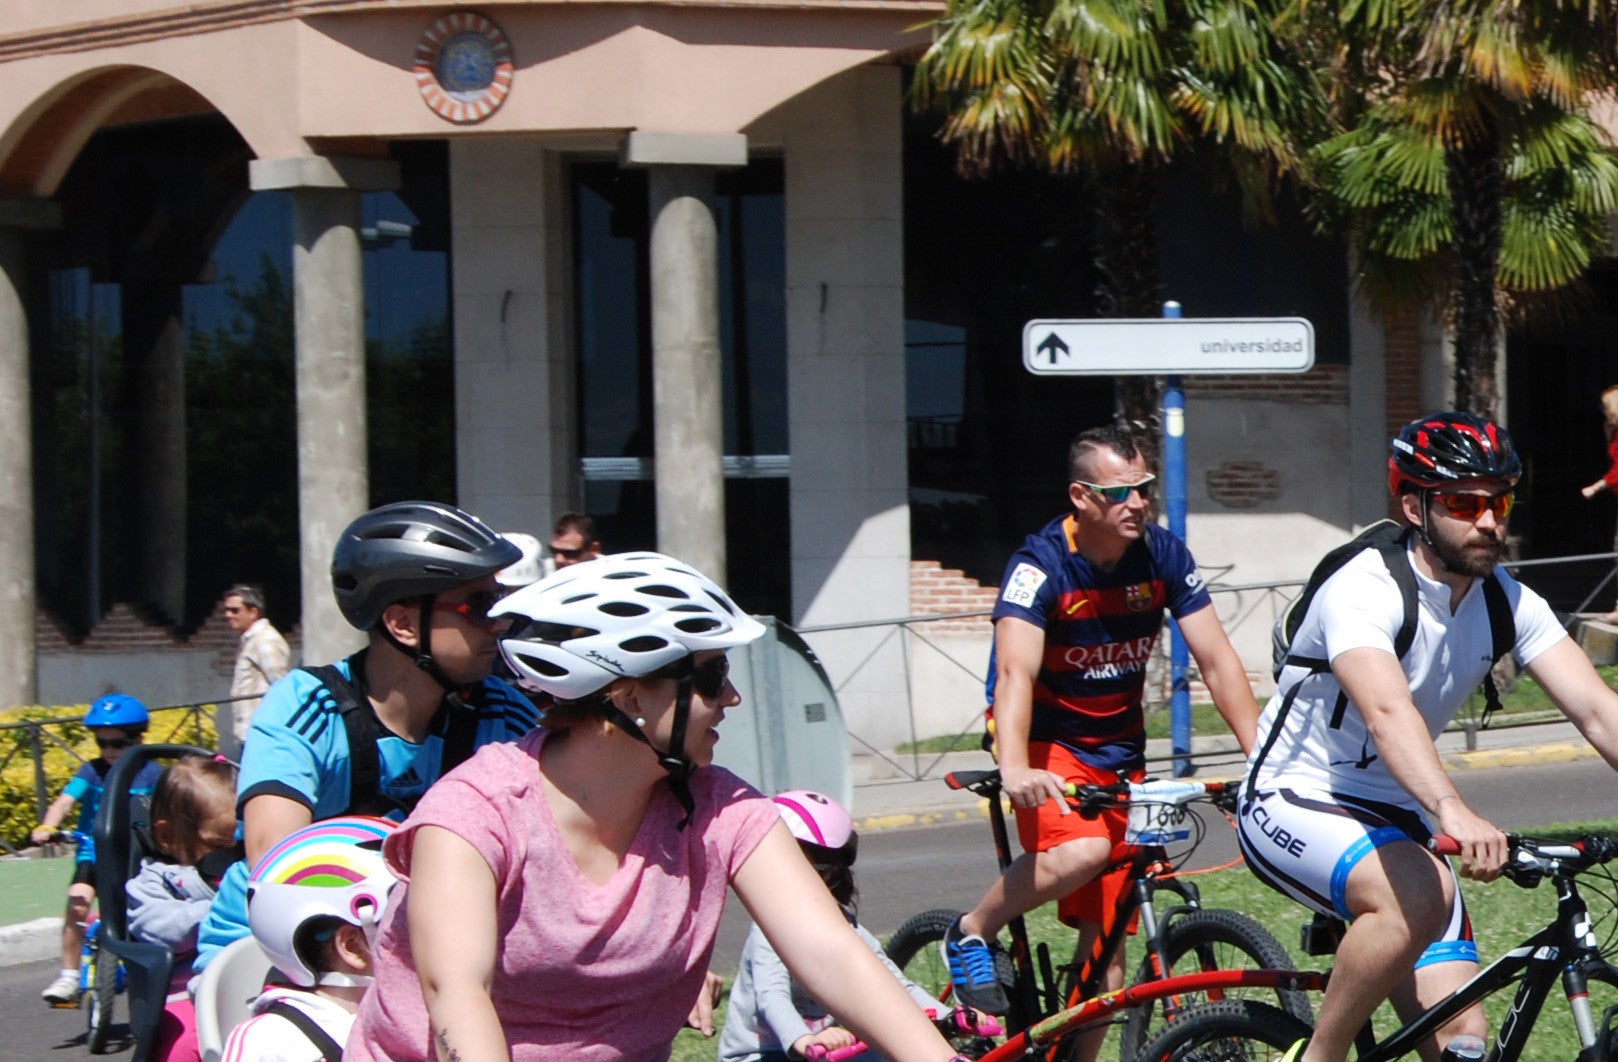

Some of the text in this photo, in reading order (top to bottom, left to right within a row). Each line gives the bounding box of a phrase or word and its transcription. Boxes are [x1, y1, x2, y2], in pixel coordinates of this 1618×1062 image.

[1201, 340, 1303, 353] universidad
[1064, 636, 1151, 670] QATAR
[1252, 805, 1307, 858] CUBE
